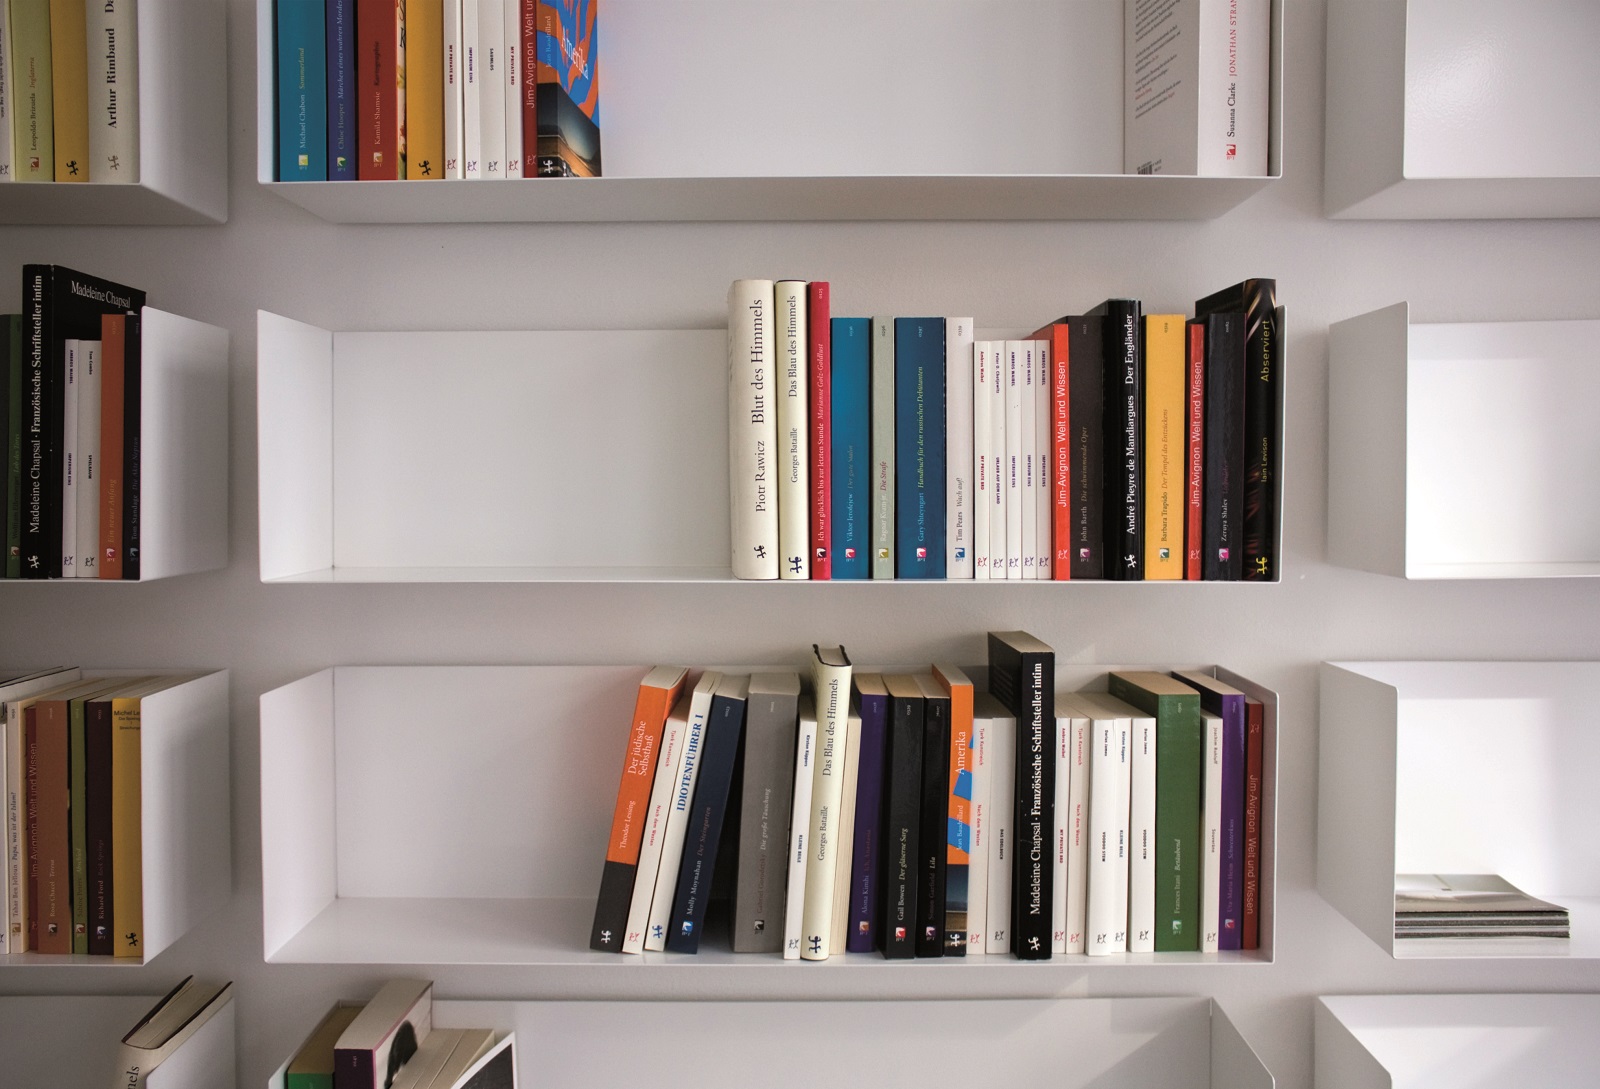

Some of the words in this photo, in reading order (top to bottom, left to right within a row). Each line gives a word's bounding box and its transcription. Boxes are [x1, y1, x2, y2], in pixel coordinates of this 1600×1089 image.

[525, 13, 534, 37] Welt
[105, 28, 116, 83] Rimbaud
[1229, 29, 1238, 76] JONATHAN
[336, 70, 345, 99] Märchen
[526, 42, 535, 108] Jim-Avignon
[298, 94, 306, 121] Chabon
[1227, 82, 1236, 106] Clarke
[107, 89, 117, 128] Arthur
[337, 103, 345, 128] Hooper
[1227, 108, 1236, 137] Susanna
[33, 275, 42, 301] intim
[71, 280, 105, 302] Madeleine
[105, 290, 131, 308] Chapsal
[786, 295, 797, 338] Himmels
[31, 303, 42, 368] Schriftsteller
[749, 299, 763, 363] Himmels
[1124, 314, 1135, 363] Engländer
[787, 340, 797, 356] des
[1260, 320, 1270, 382] Abserviert
[750, 368, 764, 390] des
[787, 358, 797, 378] Blau
[1056, 361, 1066, 398] Wissen
[1125, 366, 1134, 384] Der
[1192, 361, 1202, 398] Wissen
[31, 369, 42, 433] Französische
[788, 380, 797, 397] Das
[751, 395, 764, 424] Blut
[1057, 400, 1066, 419] und
[1192, 400, 1201, 419] und
[1057, 420, 1066, 443] Welt
[1081, 426, 1089, 443] Oper
[1126, 395, 1136, 457] Mandiargues
[1192, 421, 1201, 442] Welt
[790, 428, 798, 453] Bataille
[917, 447, 925, 456] für
[30, 440, 42, 479] Chapsal
[755, 440, 766, 482] Rawicz
[790, 455, 800, 483] Georges
[1080, 444, 1088, 489] schwimmende
[1126, 459, 1135, 471] de
[1058, 447, 1069, 507] Jim-Avignon
[1126, 473, 1137, 503] Pieyre
[1191, 447, 1202, 507] Jim-Avignon
[108, 479, 117, 506] Anfang
[755, 485, 766, 512] Piotr
[817, 490, 826, 518] glücklich
[1161, 491, 1169, 516] Trapido
[30, 481, 40, 533] Madeleine
[918, 492, 926, 525] Shteyngart
[1127, 506, 1136, 535] André
[918, 526, 926, 542] Gary
[1080, 525, 1088, 542] John
[1031, 663, 1042, 689] intim
[826, 678, 839, 720] Himmels
[825, 721, 835, 736] des
[1031, 689, 1042, 753] Schriftsteller
[630, 720, 647, 757] jüdische
[823, 738, 834, 758] Blau
[627, 757, 639, 774] Der
[638, 735, 654, 776] Selbsthaß
[676, 723, 704, 811] IDIOTENFÜHRER
[954, 731, 967, 776] Amerika
[822, 759, 832, 777] Das
[1031, 754, 1042, 816] Französische
[624, 800, 636, 822] Lessing
[654, 805, 662, 817] Nach
[1248, 774, 1258, 833] Jim-Avignon
[819, 805, 829, 831] Bataille
[956, 805, 964, 837] Baudrillard
[619, 823, 630, 849] Theodor
[817, 833, 828, 861] Georges
[899, 827, 908, 842] Sarg
[1030, 822, 1043, 861] Chapsal
[1247, 837, 1256, 858] Welt
[11, 845, 19, 861] Papa,
[899, 843, 908, 868] gläserne
[689, 860, 702, 895] Moynahan
[898, 868, 906, 881] Der
[1247, 860, 1255, 878] und
[897, 884, 905, 906] Bowen
[1030, 862, 1041, 915] Madeleine
[1246, 880, 1255, 915] Wissen
[686, 896, 696, 915] Molly
[897, 906, 905, 920] Gail
